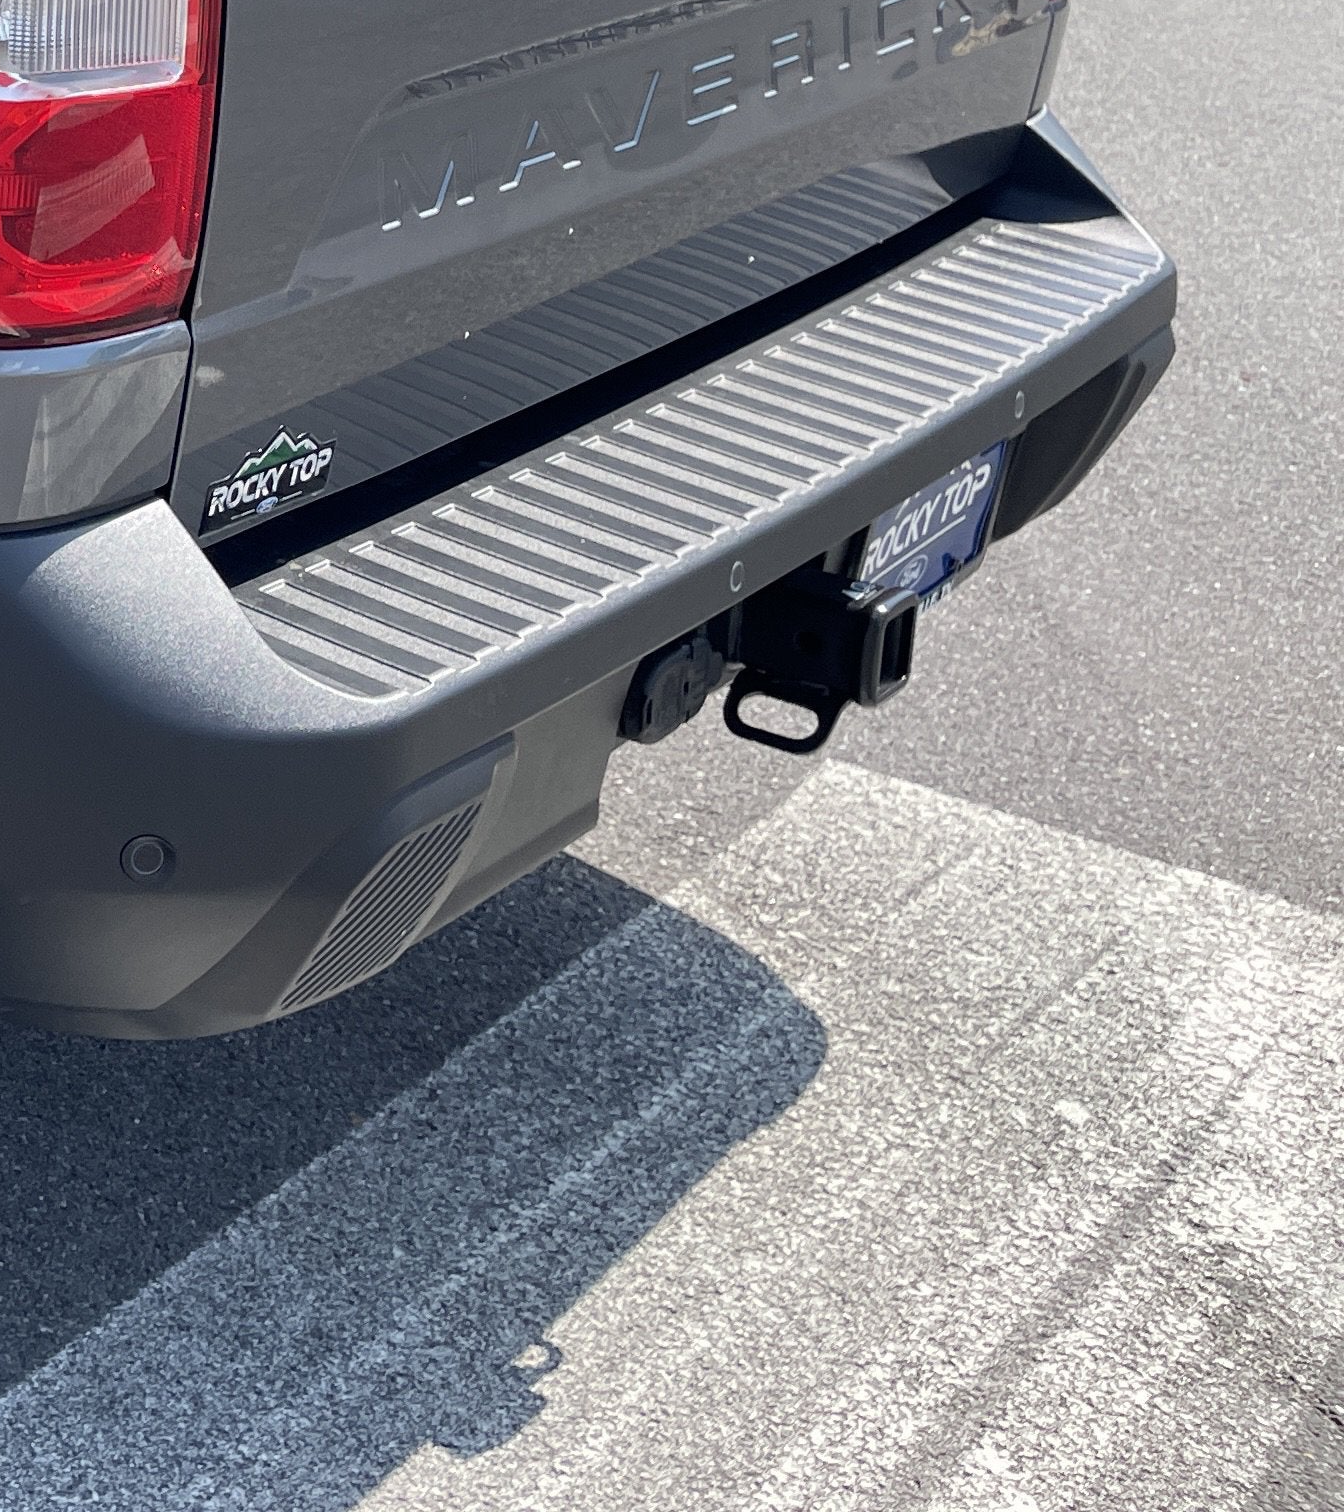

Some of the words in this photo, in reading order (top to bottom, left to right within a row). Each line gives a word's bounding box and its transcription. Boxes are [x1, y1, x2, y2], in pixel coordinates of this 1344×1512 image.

[208, 463, 288, 518] ROCKY
[289, 447, 332, 487] TOP
[860, 492, 942, 582] ROCKY
[940, 462, 992, 524] TOP
